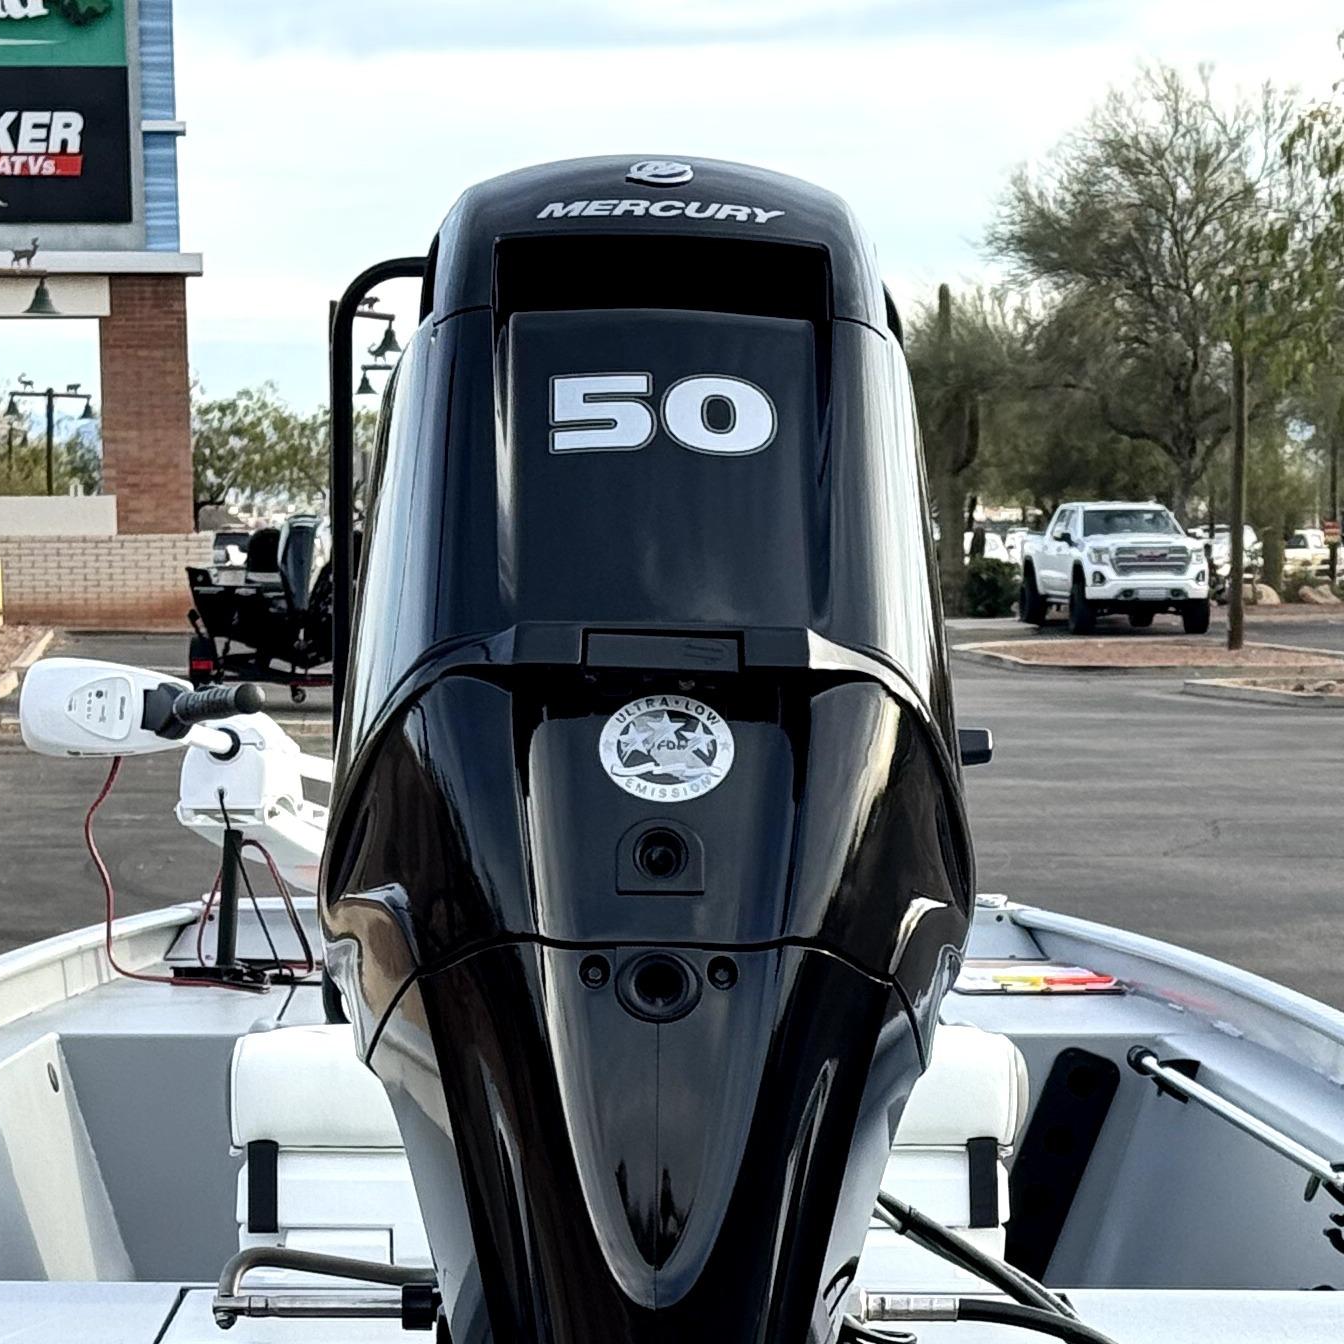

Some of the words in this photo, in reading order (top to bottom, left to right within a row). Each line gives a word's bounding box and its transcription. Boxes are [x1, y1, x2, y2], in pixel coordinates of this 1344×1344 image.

[536, 199, 786, 224] MERCURY
[549, 371, 778, 457] 50
[615, 697, 669, 724] ULTRA
[685, 700, 721, 726] LOW
[624, 777, 712, 799] EMISSION
